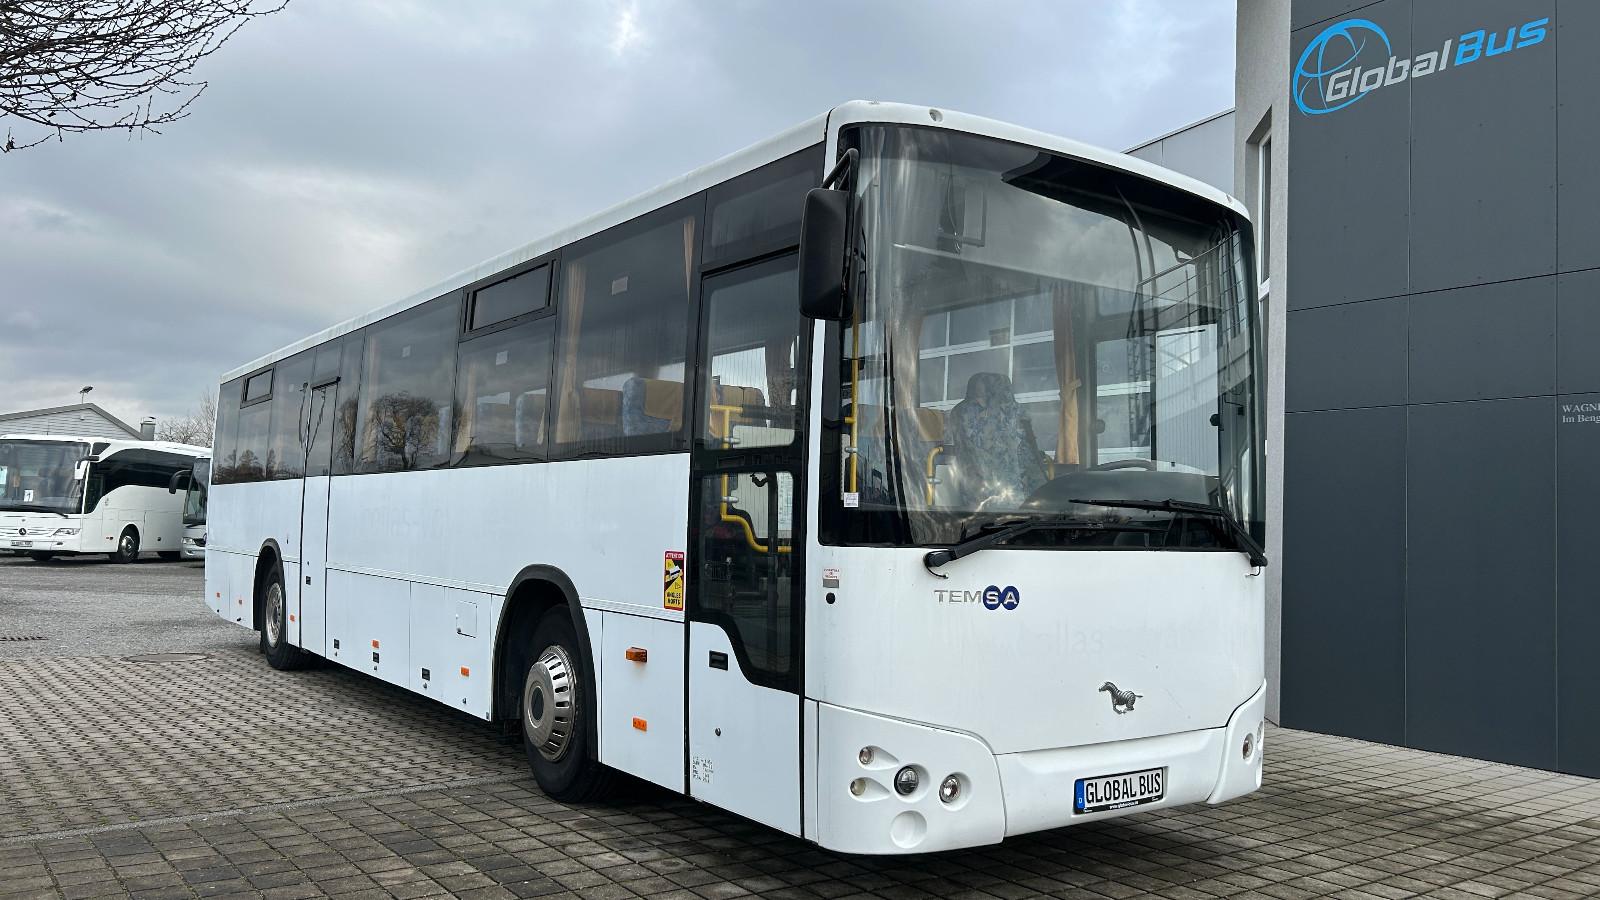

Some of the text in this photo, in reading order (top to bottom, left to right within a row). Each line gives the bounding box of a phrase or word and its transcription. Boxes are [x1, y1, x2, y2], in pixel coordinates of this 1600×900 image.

[1562, 415, 1575, 423] Im
[934, 589, 1018, 605] TEMSA
[1085, 772, 1161, 804] GLOBAL BUS
